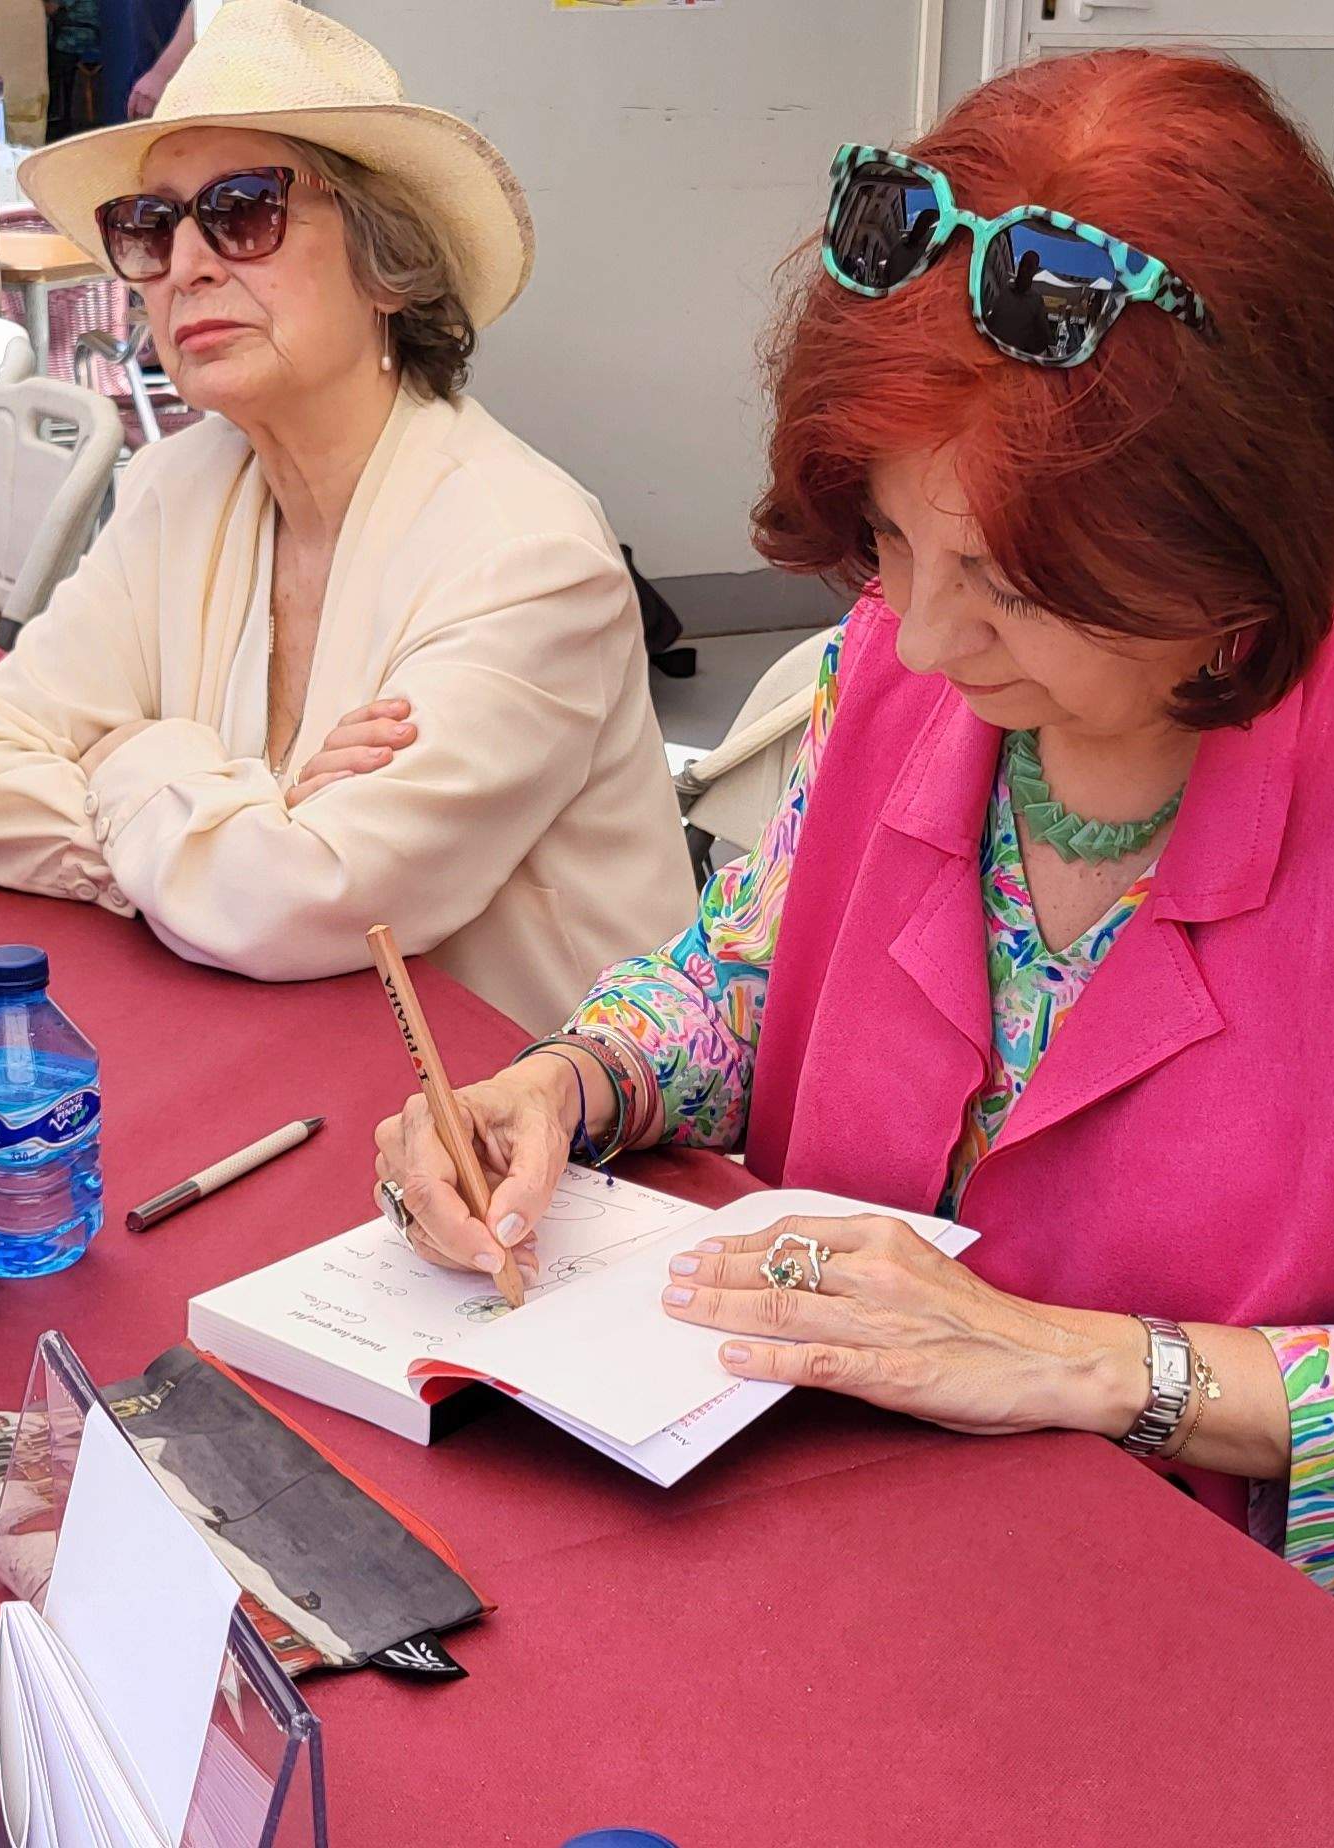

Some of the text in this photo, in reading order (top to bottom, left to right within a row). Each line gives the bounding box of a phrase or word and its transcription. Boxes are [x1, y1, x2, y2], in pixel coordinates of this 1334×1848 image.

[385, 974, 418, 1052] PRAHA
[419, 1069, 429, 1083] I
[54, 1093, 84, 1114] MONTE
[57, 1102, 83, 1121] PINOS
